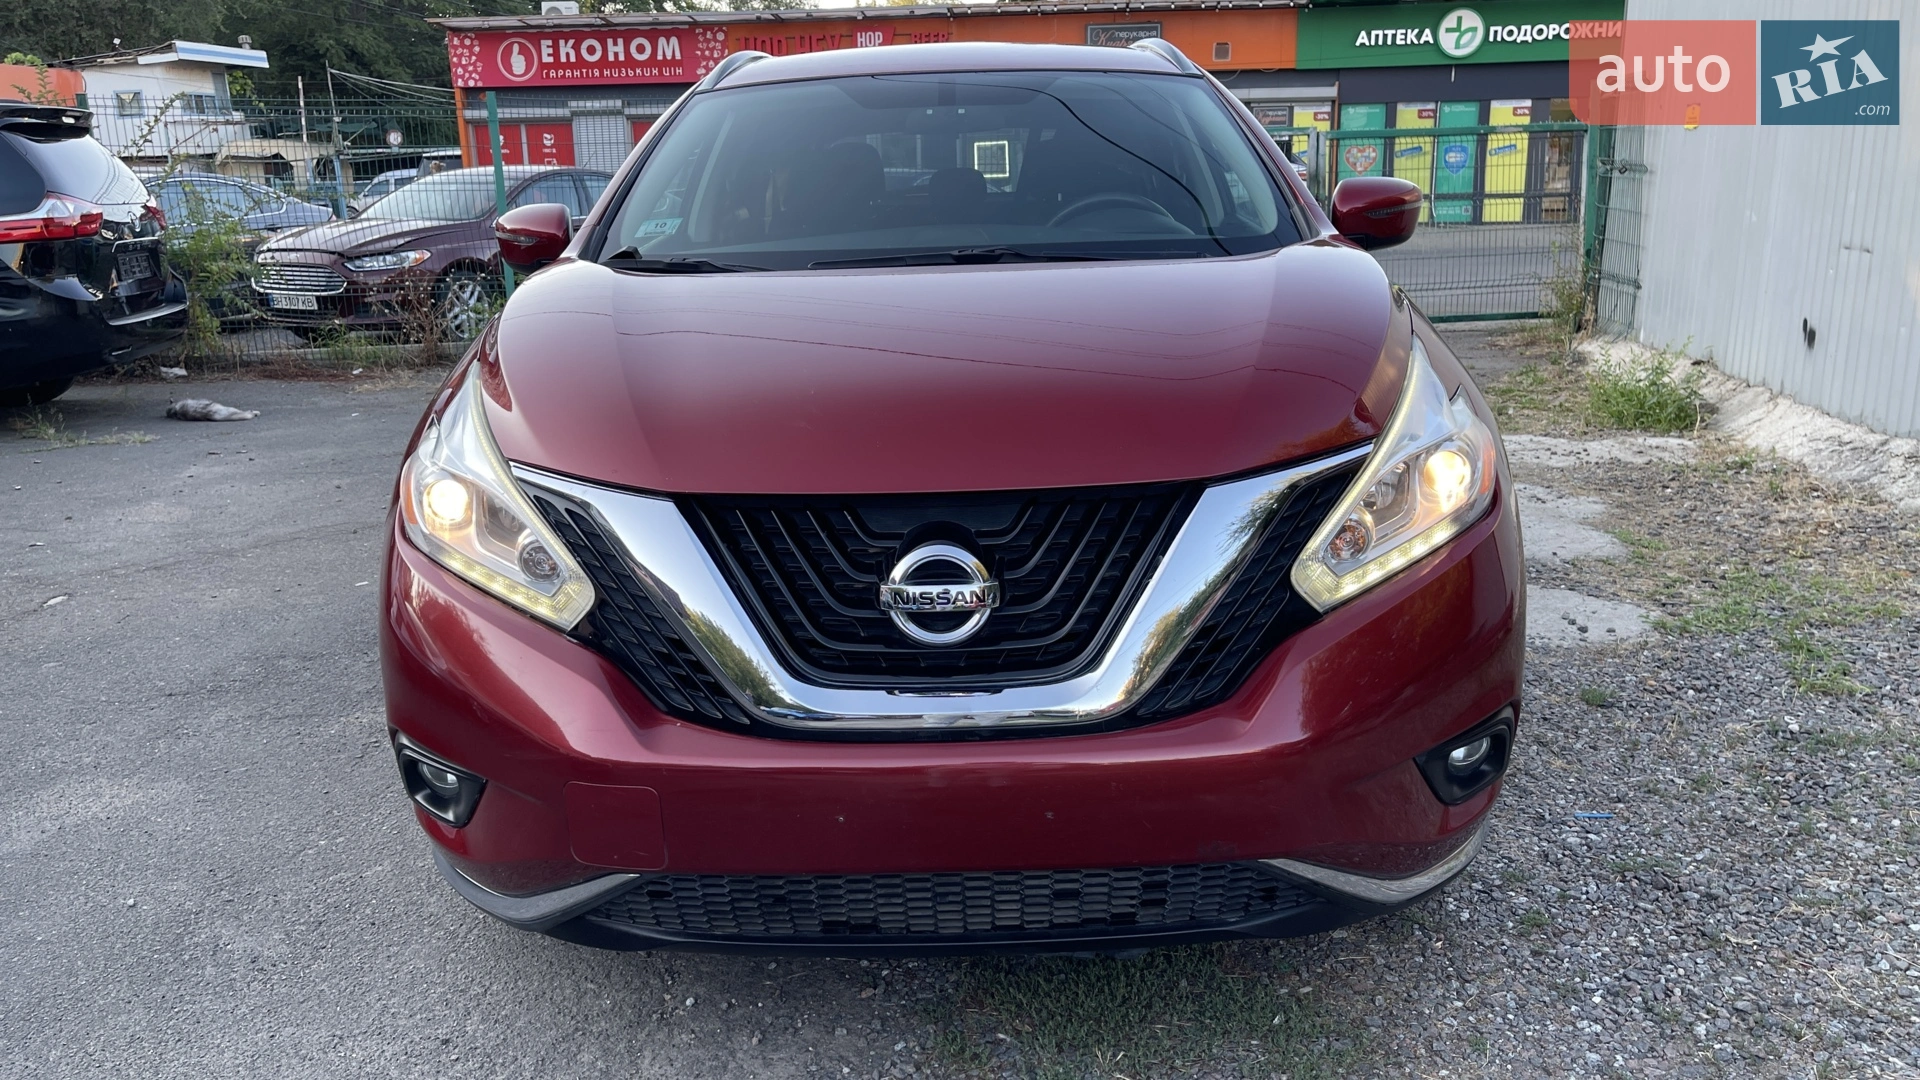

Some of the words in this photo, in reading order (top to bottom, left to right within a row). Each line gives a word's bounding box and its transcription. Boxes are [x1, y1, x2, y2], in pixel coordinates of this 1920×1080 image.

[856, 31, 883, 48] HOP
[1115, 30, 1157, 39] перукарня
[1355, 28, 1434, 47] АПТЕКА
[540, 36, 682, 63] ЕКОНОМ
[542, 68, 600, 79] ГАРАНТІЯ
[603, 67, 660, 77] НИЗЬКИХ
[662, 66, 683, 77] ЦІН
[892, 588, 986, 606] NISSAN
